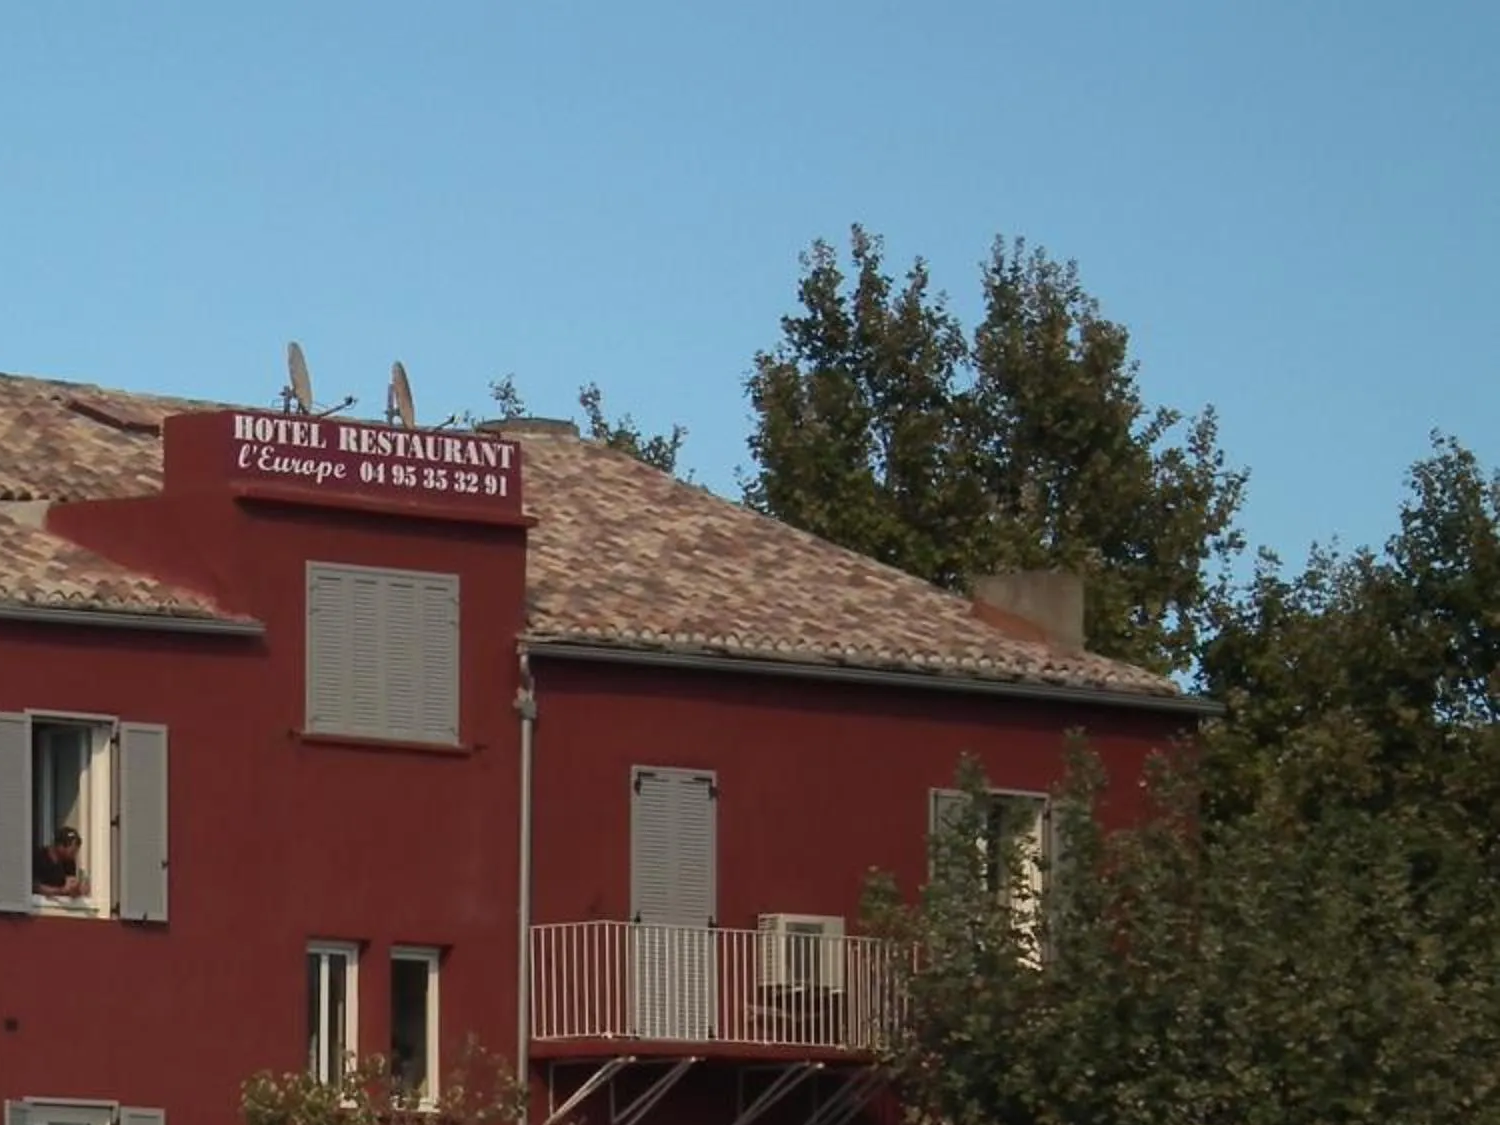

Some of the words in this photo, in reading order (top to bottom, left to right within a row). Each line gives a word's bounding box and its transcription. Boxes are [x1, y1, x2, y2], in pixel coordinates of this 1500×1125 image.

[234, 414, 328, 449] HOTEL
[339, 425, 514, 469] RESTAURANT
[238, 442, 348, 485] l'Europe
[359, 461, 386, 484] 04
[391, 464, 417, 487] 95
[423, 467, 448, 491] 35
[453, 470, 479, 494] 32
[484, 474, 507, 497] 91
